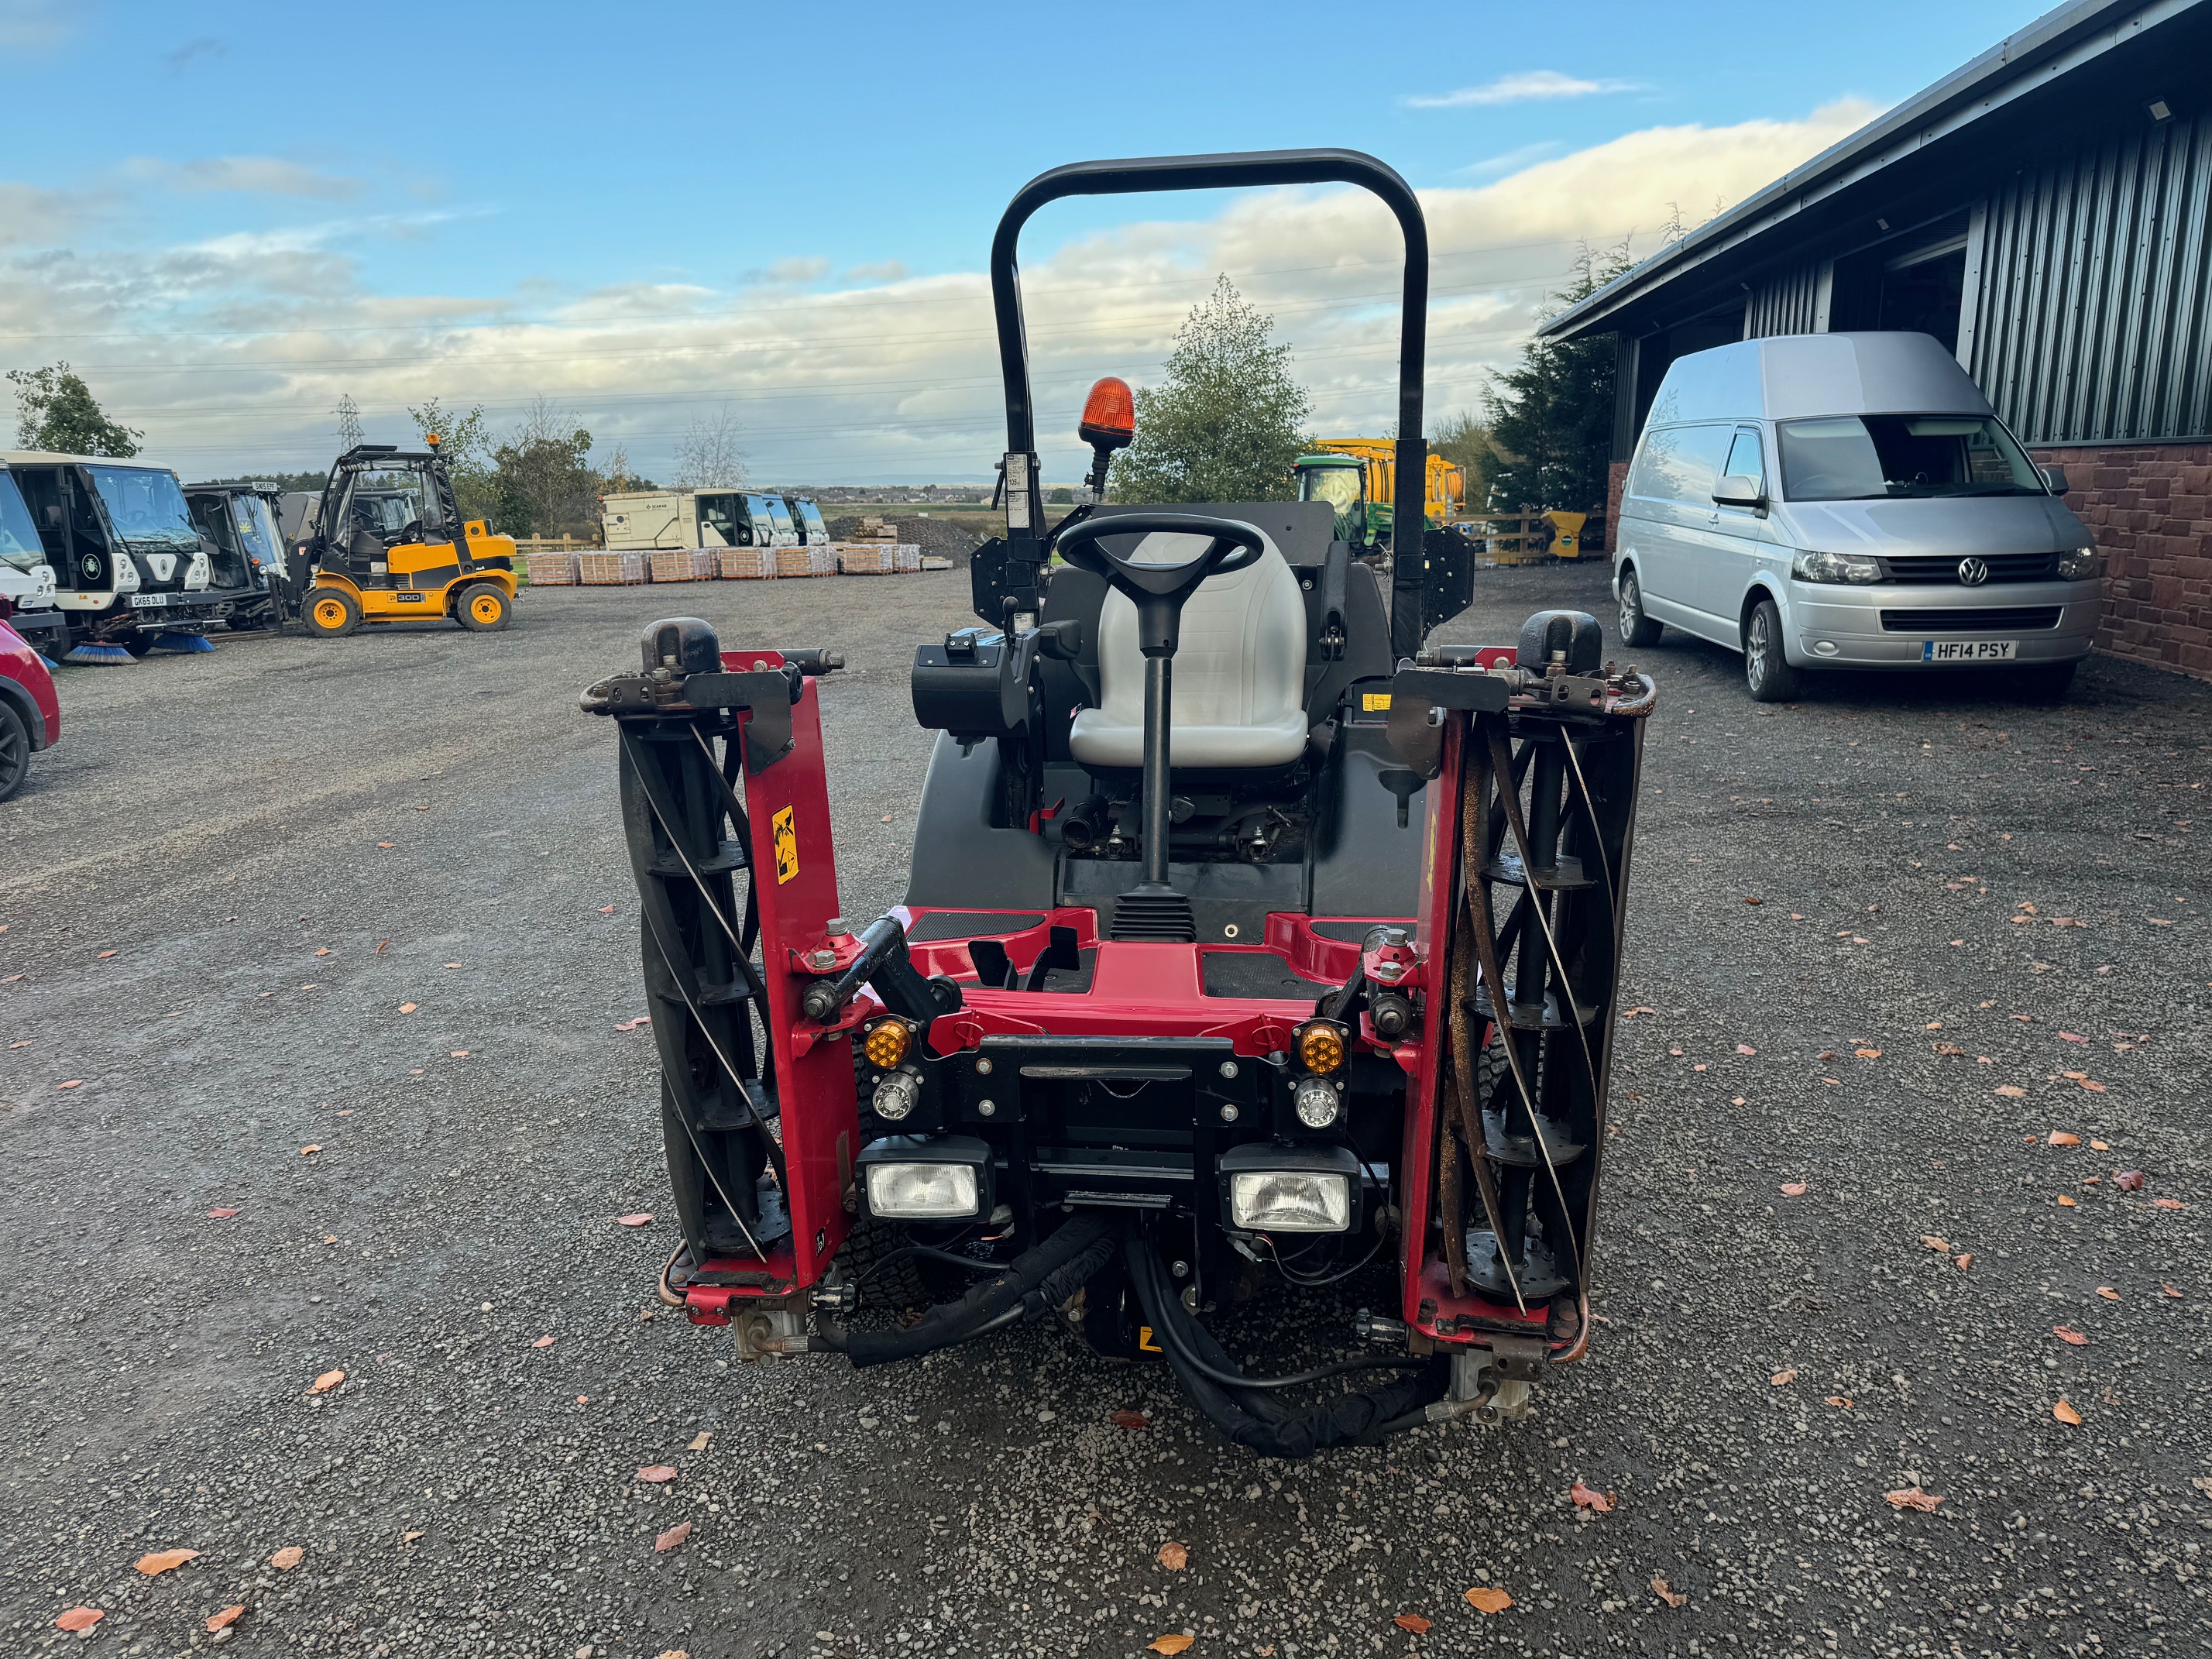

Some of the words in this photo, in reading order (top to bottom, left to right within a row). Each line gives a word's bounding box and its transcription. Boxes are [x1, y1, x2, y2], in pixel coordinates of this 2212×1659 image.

[134, 596, 151, 606] GK65
[151, 595, 164, 604] DLU
[1938, 644, 1973, 658] HF14
[1978, 643, 2010, 658] PSY
